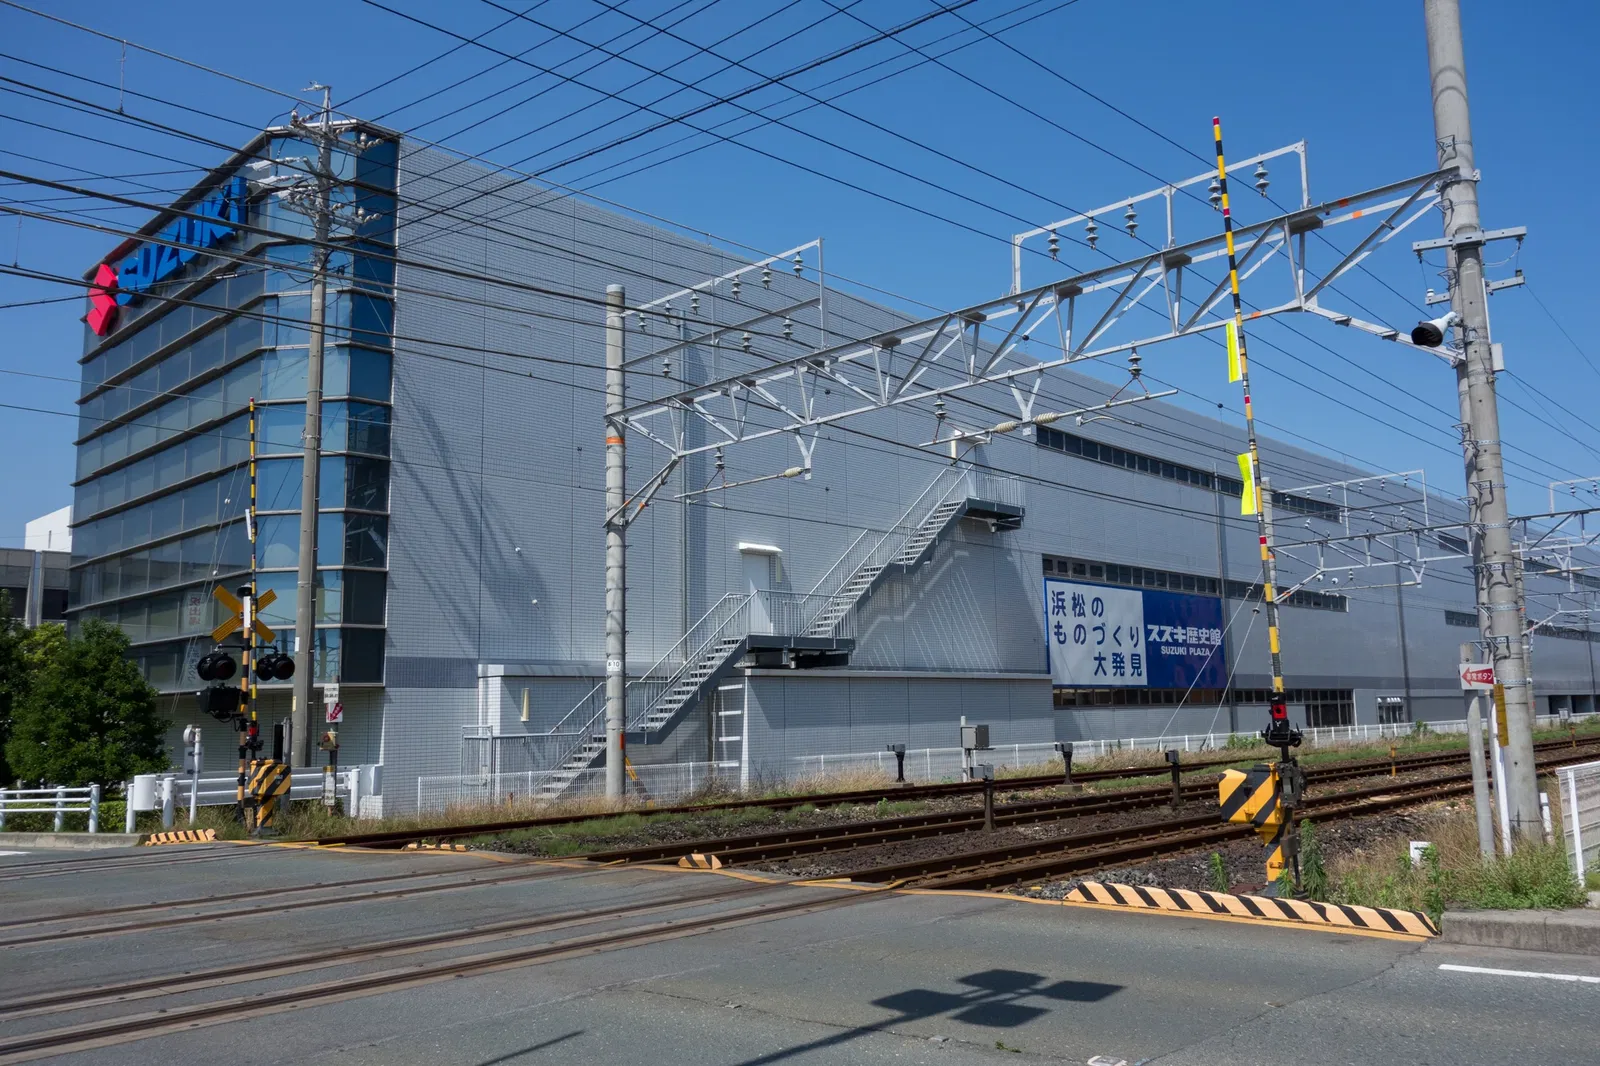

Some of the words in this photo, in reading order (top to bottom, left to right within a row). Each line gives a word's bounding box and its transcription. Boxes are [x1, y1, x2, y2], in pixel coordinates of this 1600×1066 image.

[115, 176, 247, 307] SUZUKI
[1051, 590, 1104, 618] 浜松の
[1053, 621, 1140, 649] ものづくり
[1147, 624, 1222, 645] スズキ歴史館
[1093, 651, 1143, 677] 大発見
[1161, 646, 1187, 655] SUZUKI
[1189, 647, 1210, 656] PLAZA
